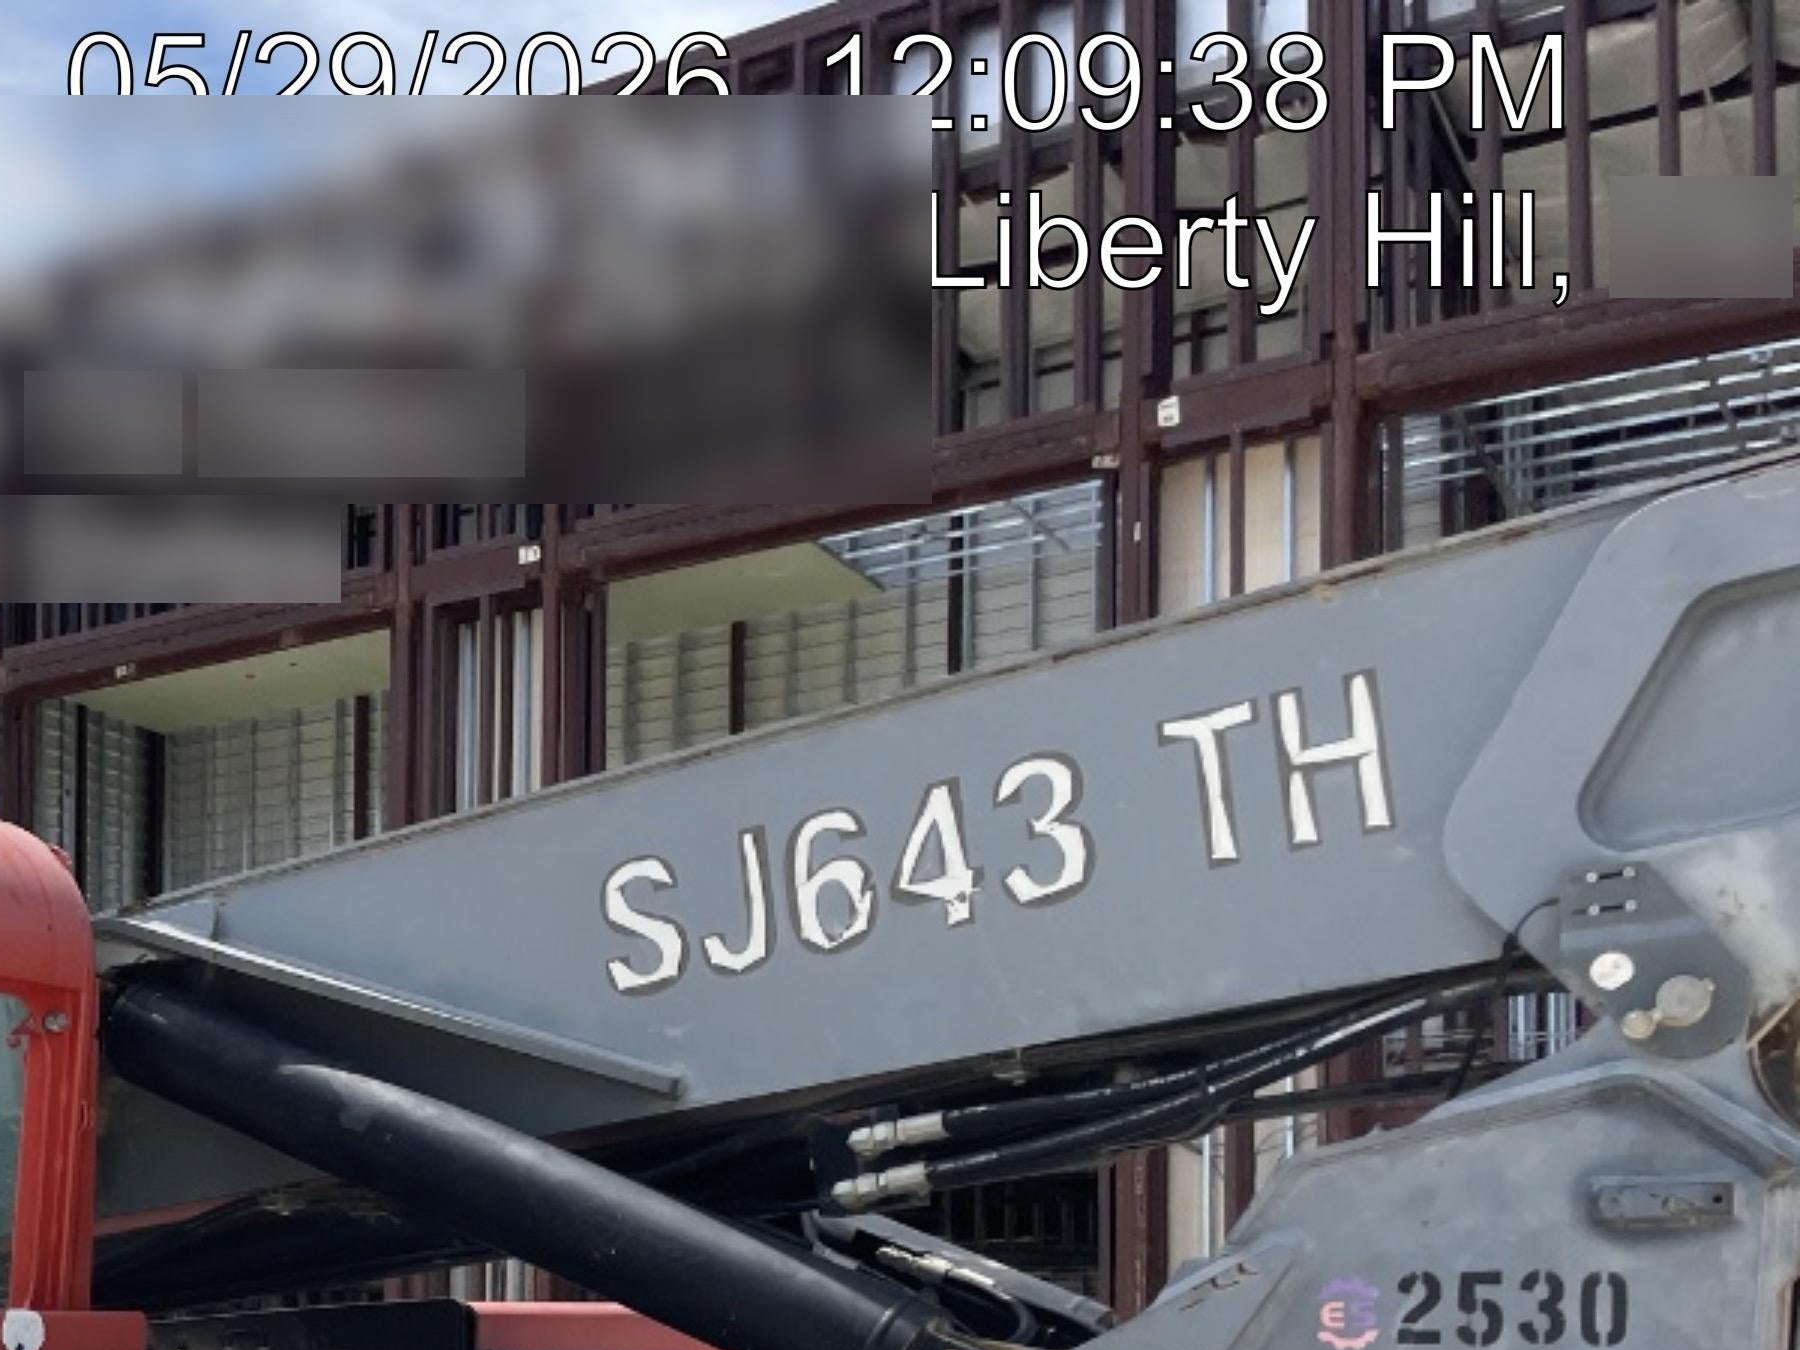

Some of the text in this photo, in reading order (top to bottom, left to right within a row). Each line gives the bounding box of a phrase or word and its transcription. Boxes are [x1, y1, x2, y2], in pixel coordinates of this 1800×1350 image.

[602, 668, 1394, 994] SJ643 TH
[1397, 1269, 1628, 1347] 2530
